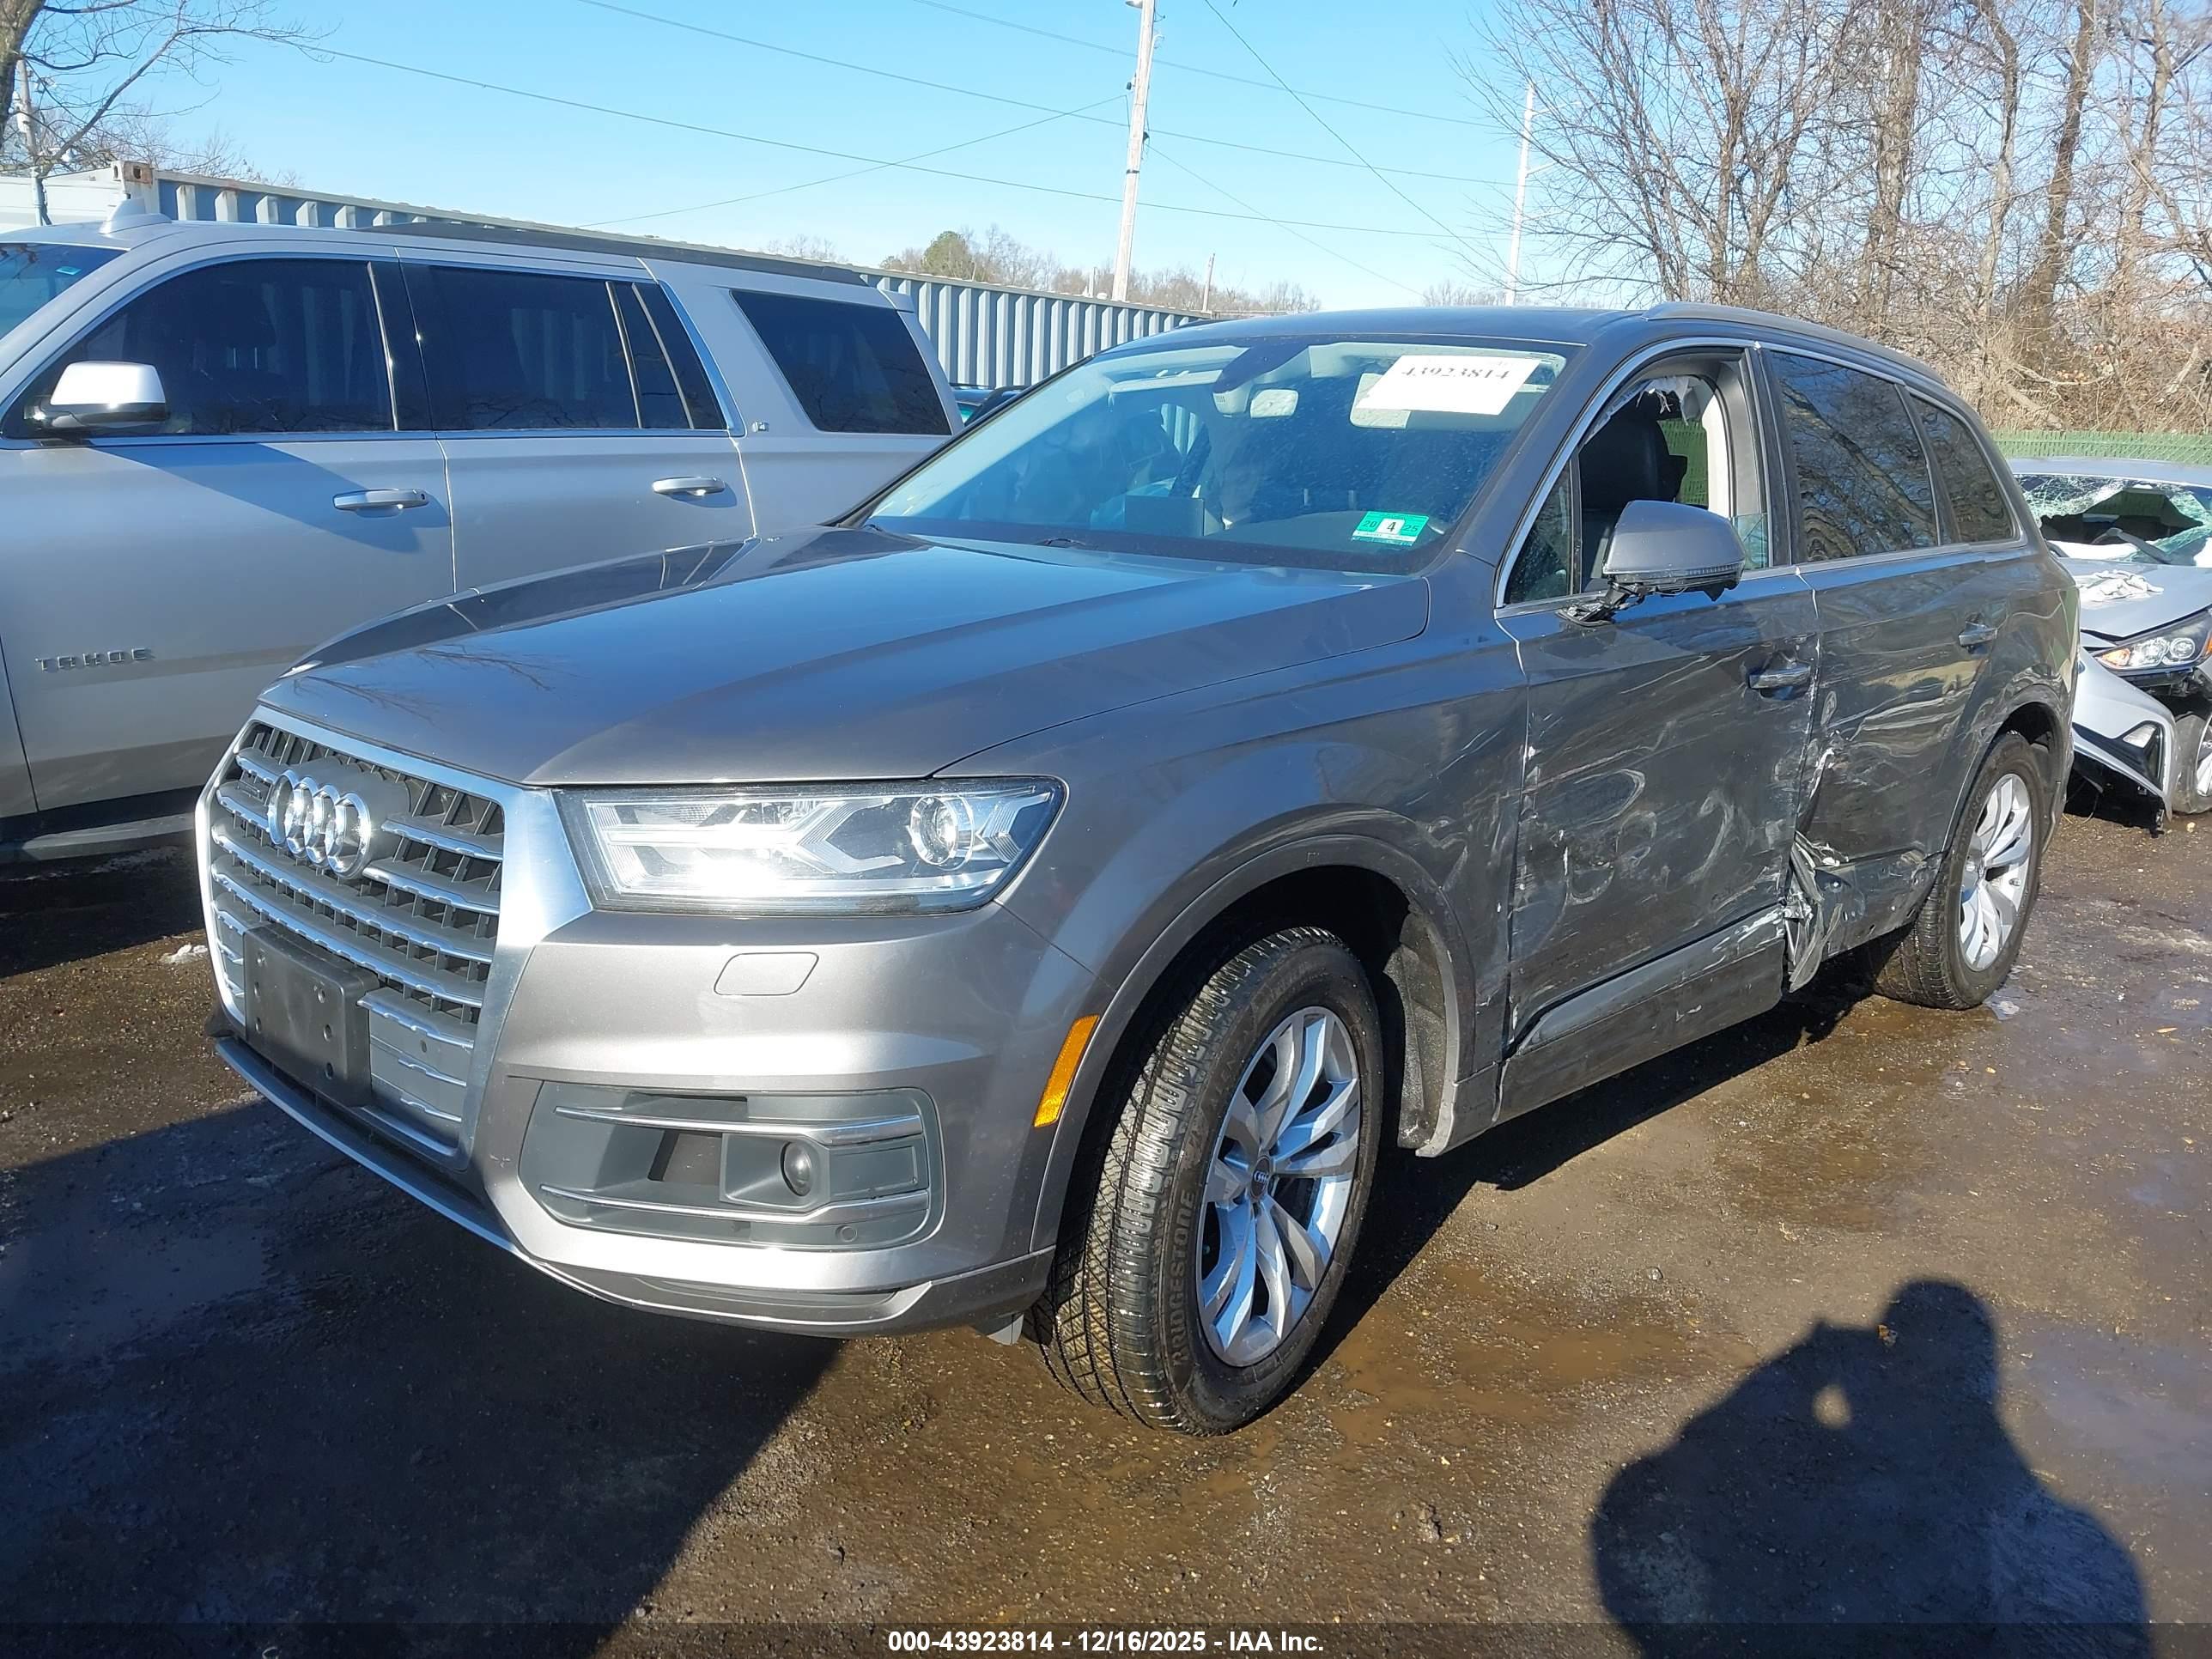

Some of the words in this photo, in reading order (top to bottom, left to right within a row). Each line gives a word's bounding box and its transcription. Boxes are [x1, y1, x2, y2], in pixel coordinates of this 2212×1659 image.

[1401, 367, 1510, 380] 43923814
[1386, 521, 1397, 532] 4
[34, 647, 149, 671] TAHOE
[1169, 1188, 1195, 1367] BRIDGESTONE
